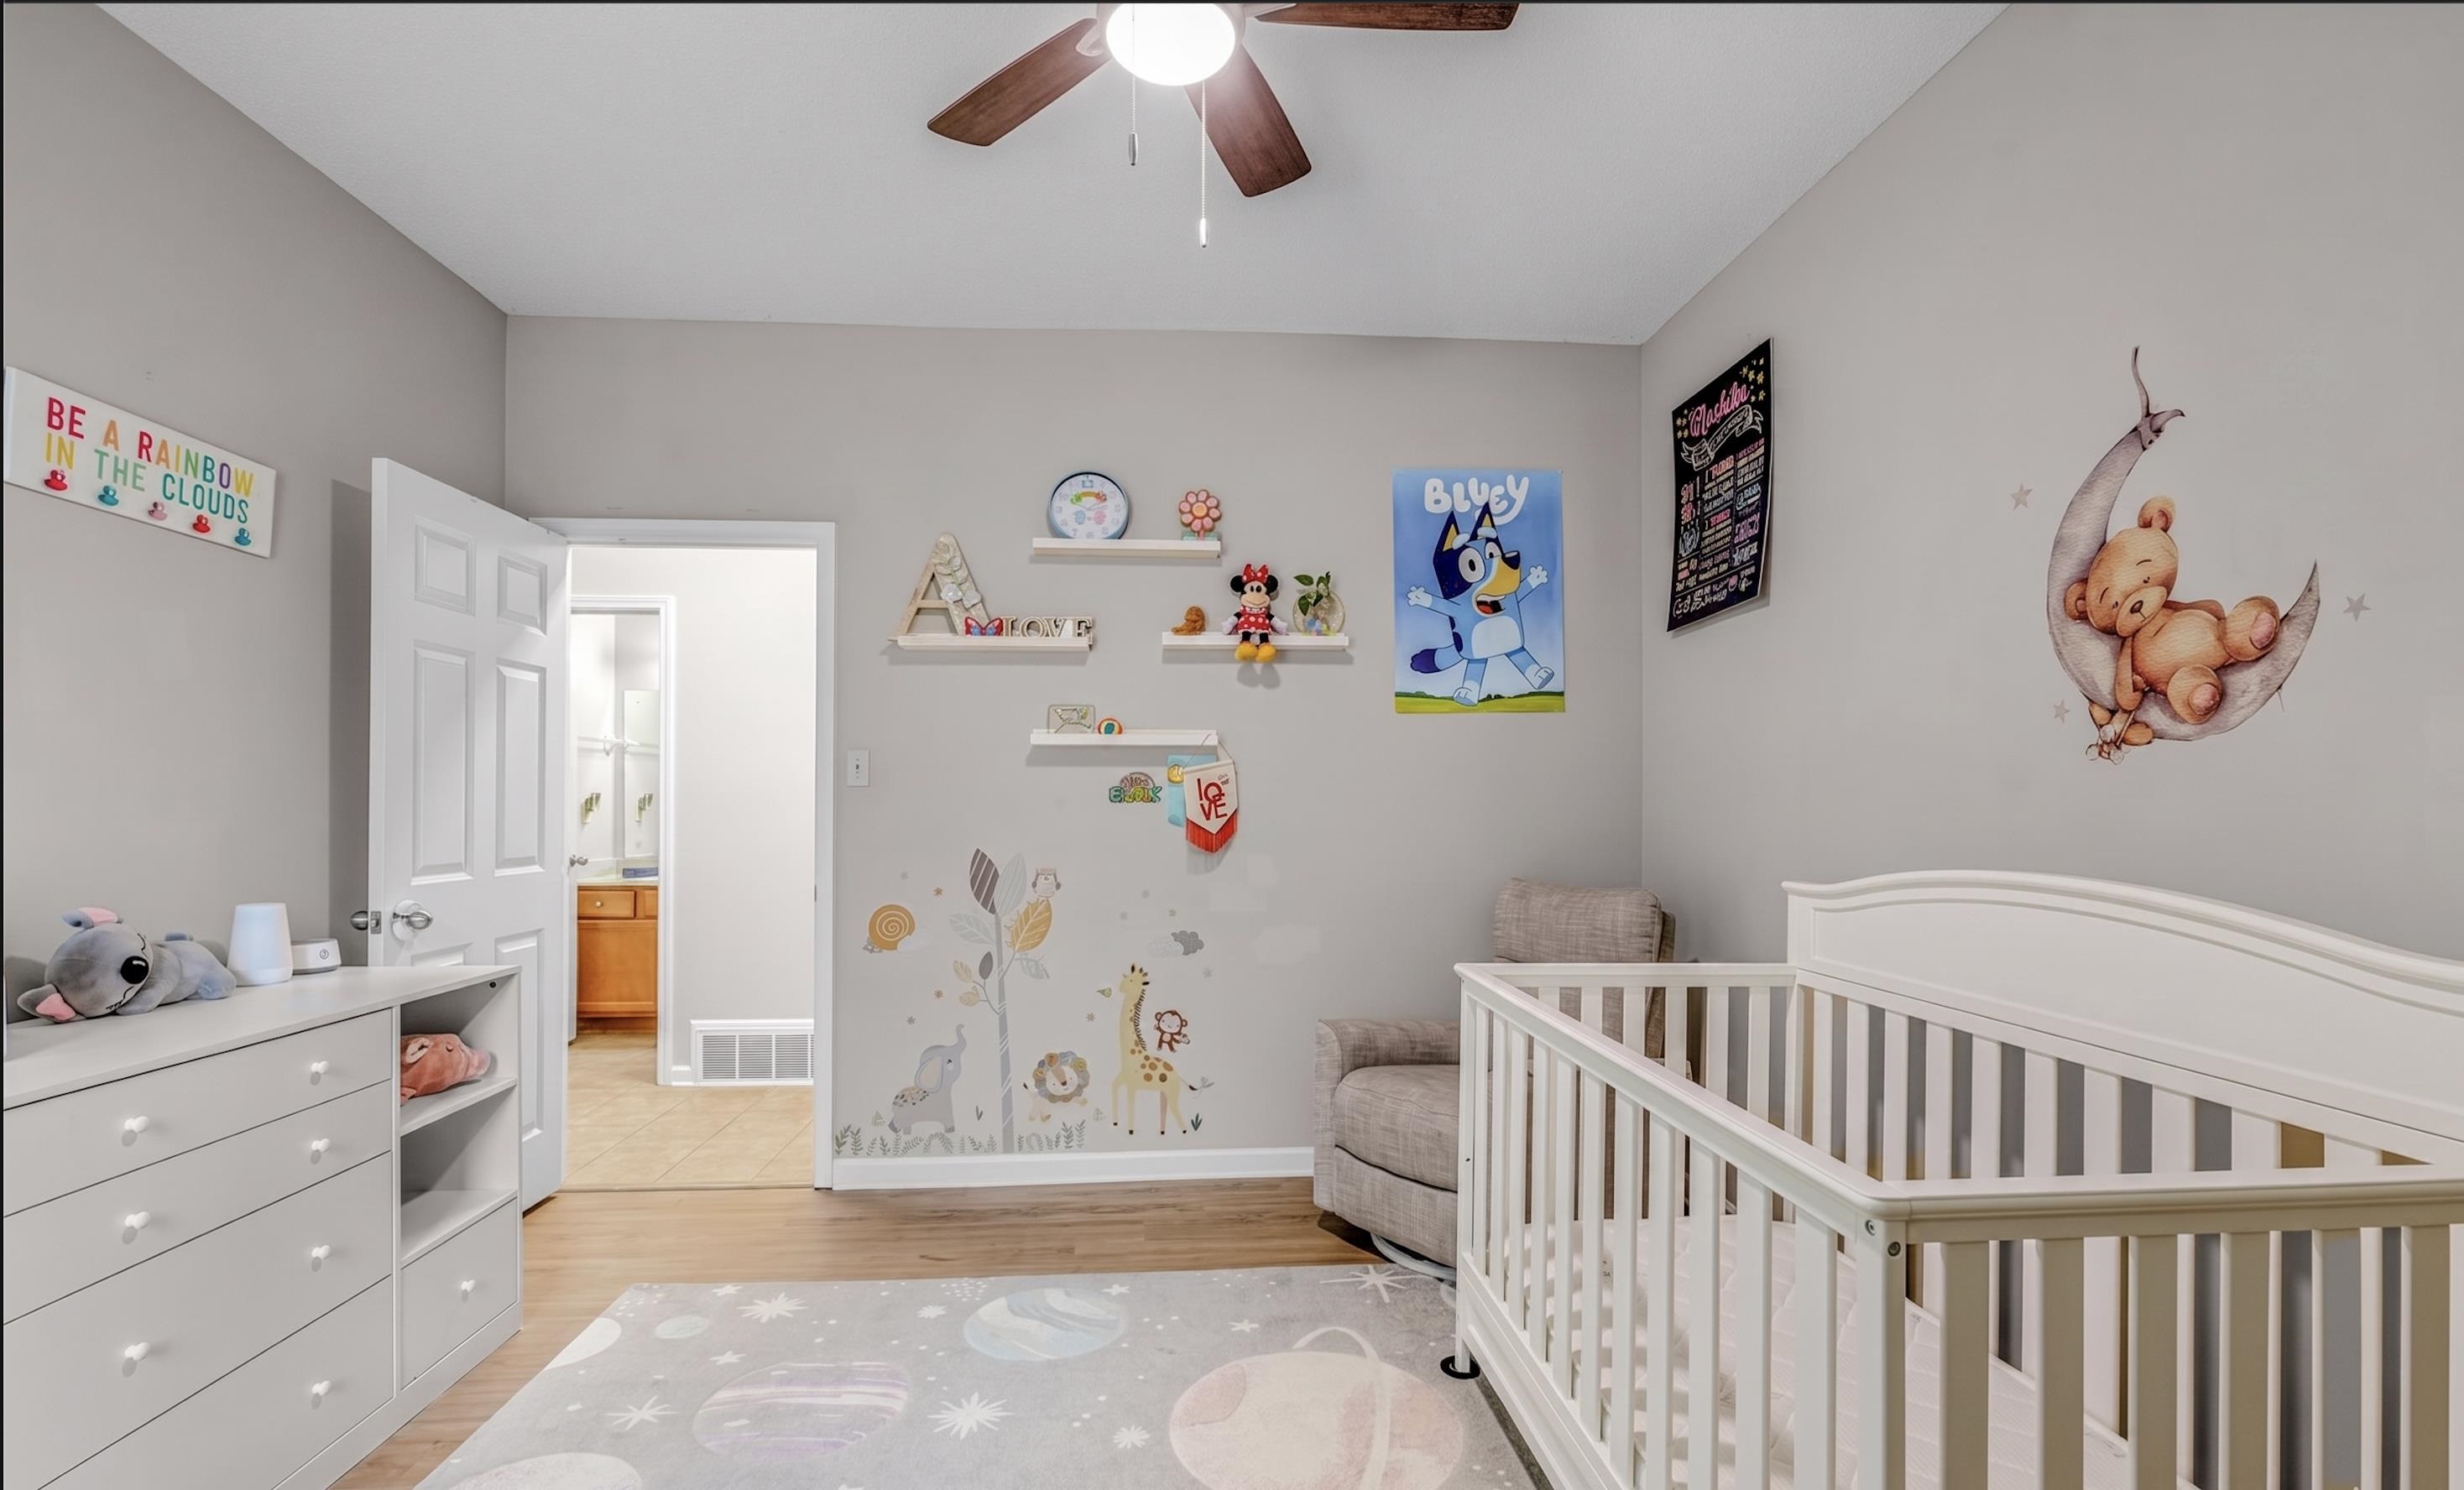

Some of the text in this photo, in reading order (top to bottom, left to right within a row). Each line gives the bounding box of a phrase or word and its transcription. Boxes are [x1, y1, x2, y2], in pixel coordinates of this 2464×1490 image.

[44, 432, 249, 524] IN THE CLOUDS
[47, 397, 254, 498] BE A RAINBOW
[1423, 475, 1529, 525] BLUEY
[1001, 616, 1093, 643] LOVE
